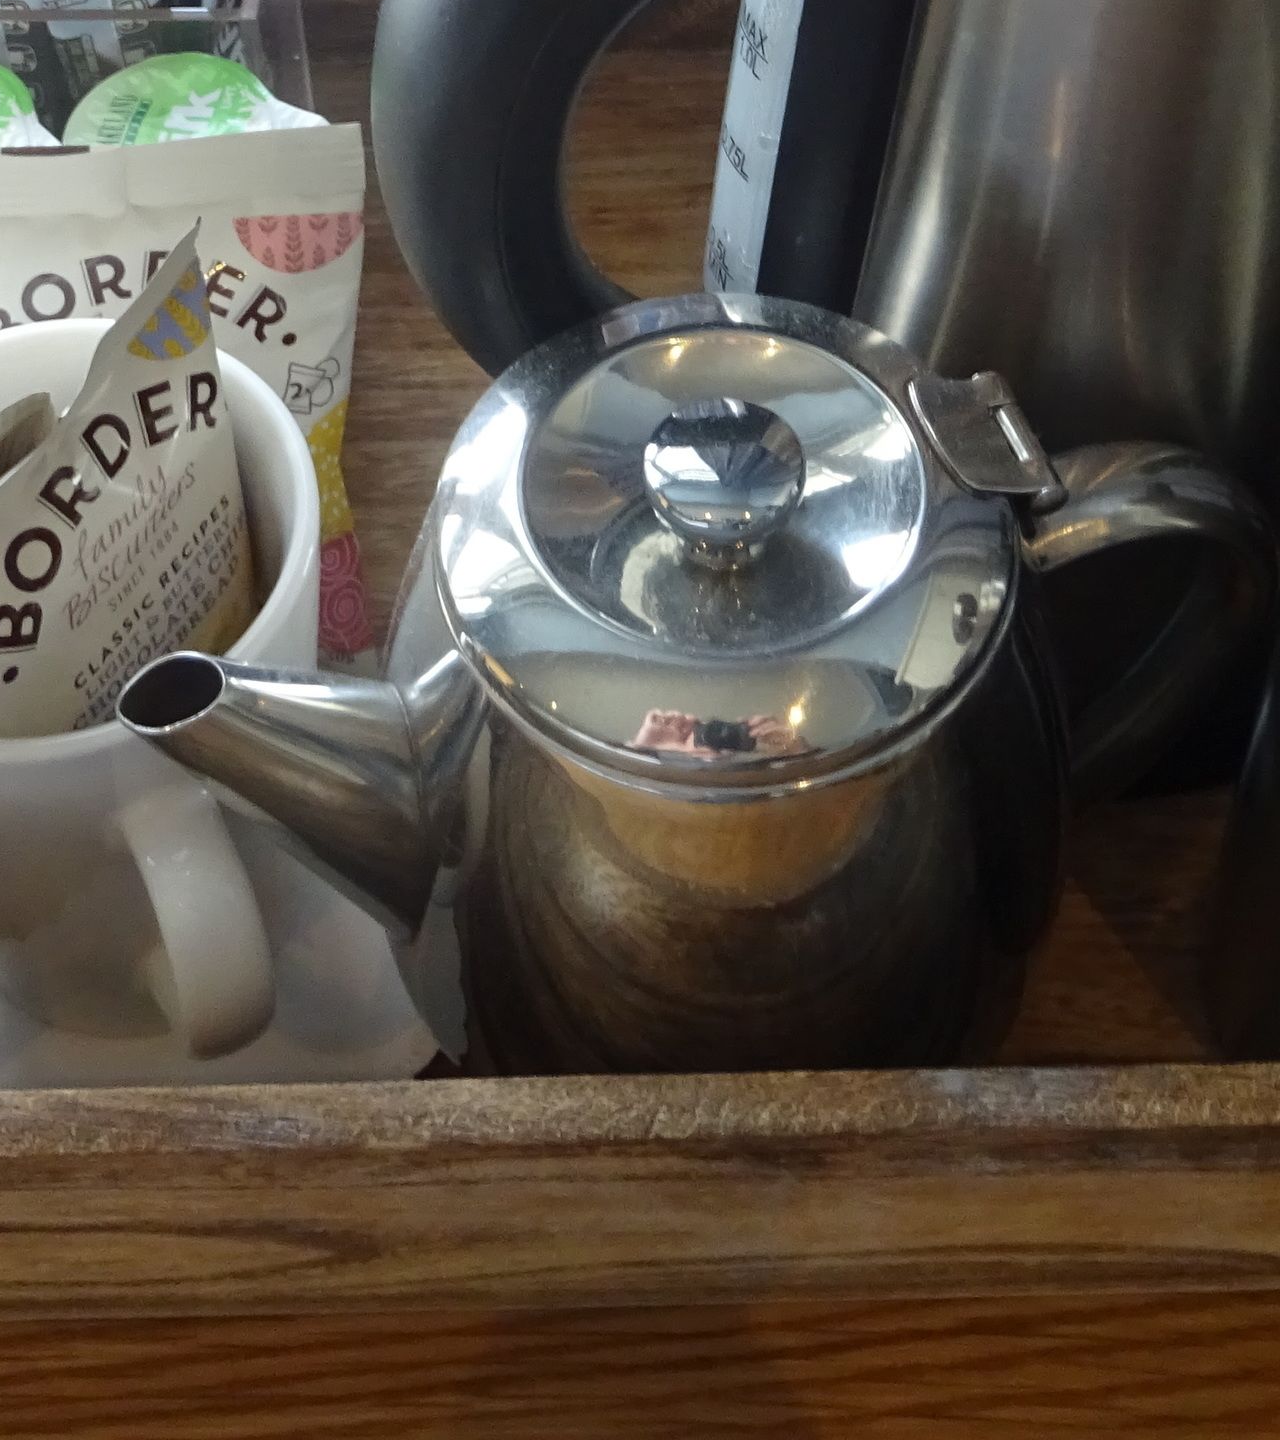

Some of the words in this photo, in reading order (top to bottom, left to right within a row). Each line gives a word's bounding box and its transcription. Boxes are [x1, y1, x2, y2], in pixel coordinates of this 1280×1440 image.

[742, 1, 768, 57] MAX
[74, 591, 154, 689] CLASSIC
[159, 494, 229, 590] RECIPES
